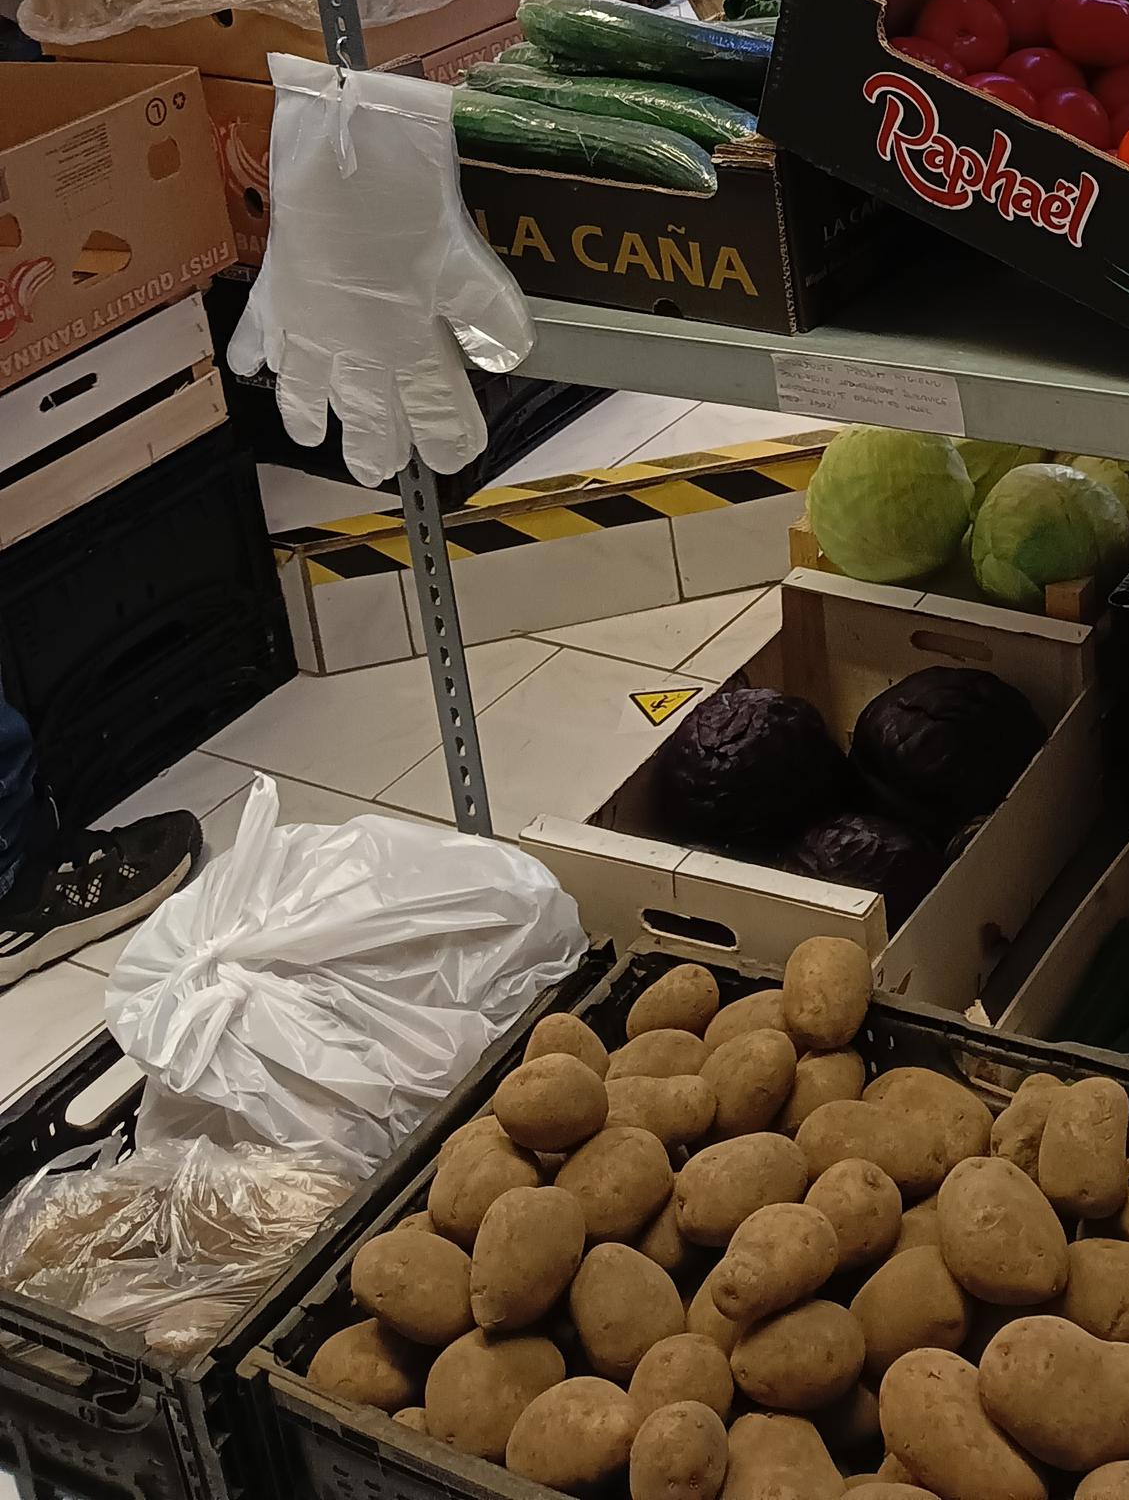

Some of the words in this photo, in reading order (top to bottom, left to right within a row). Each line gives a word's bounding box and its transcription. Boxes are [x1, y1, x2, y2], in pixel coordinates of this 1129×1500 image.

[862, 71, 1101, 248] Raphaël
[179, 241, 229, 284] FIRST
[571, 223, 759, 297] CAÑA
[91, 272, 175, 328] QUALITY
